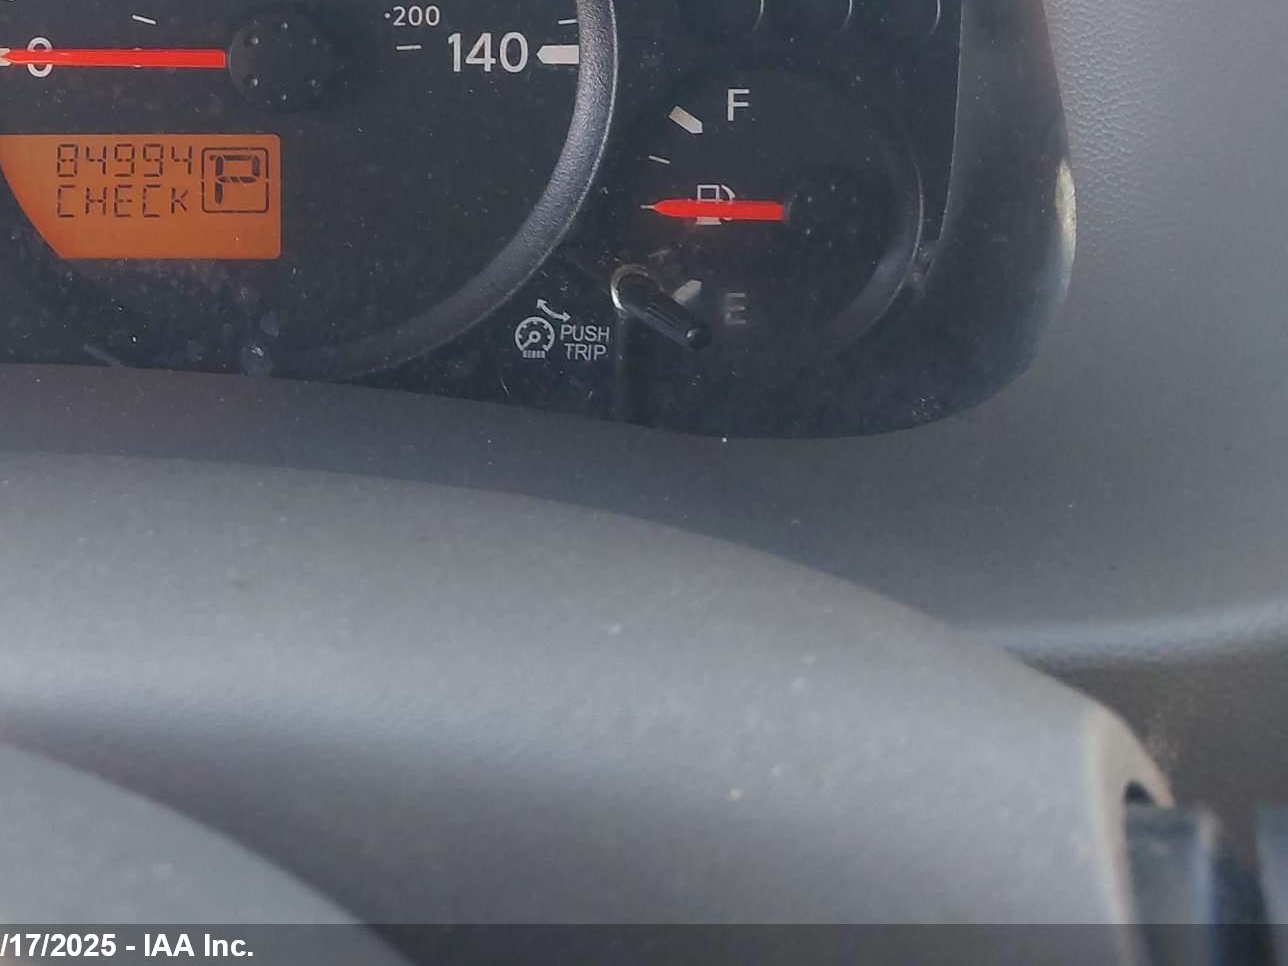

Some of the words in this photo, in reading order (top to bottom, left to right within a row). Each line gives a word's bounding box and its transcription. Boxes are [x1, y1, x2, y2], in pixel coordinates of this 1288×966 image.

[393, 5, 440, 26] 200
[447, 31, 529, 73] 140
[726, 88, 750, 122] F
[57, 144, 193, 177] 84994
[209, 155, 261, 204] P
[57, 185, 189, 218] CHECK
[724, 292, 747, 325] E
[559, 324, 610, 343] PUSH
[564, 343, 607, 361] TRIP
